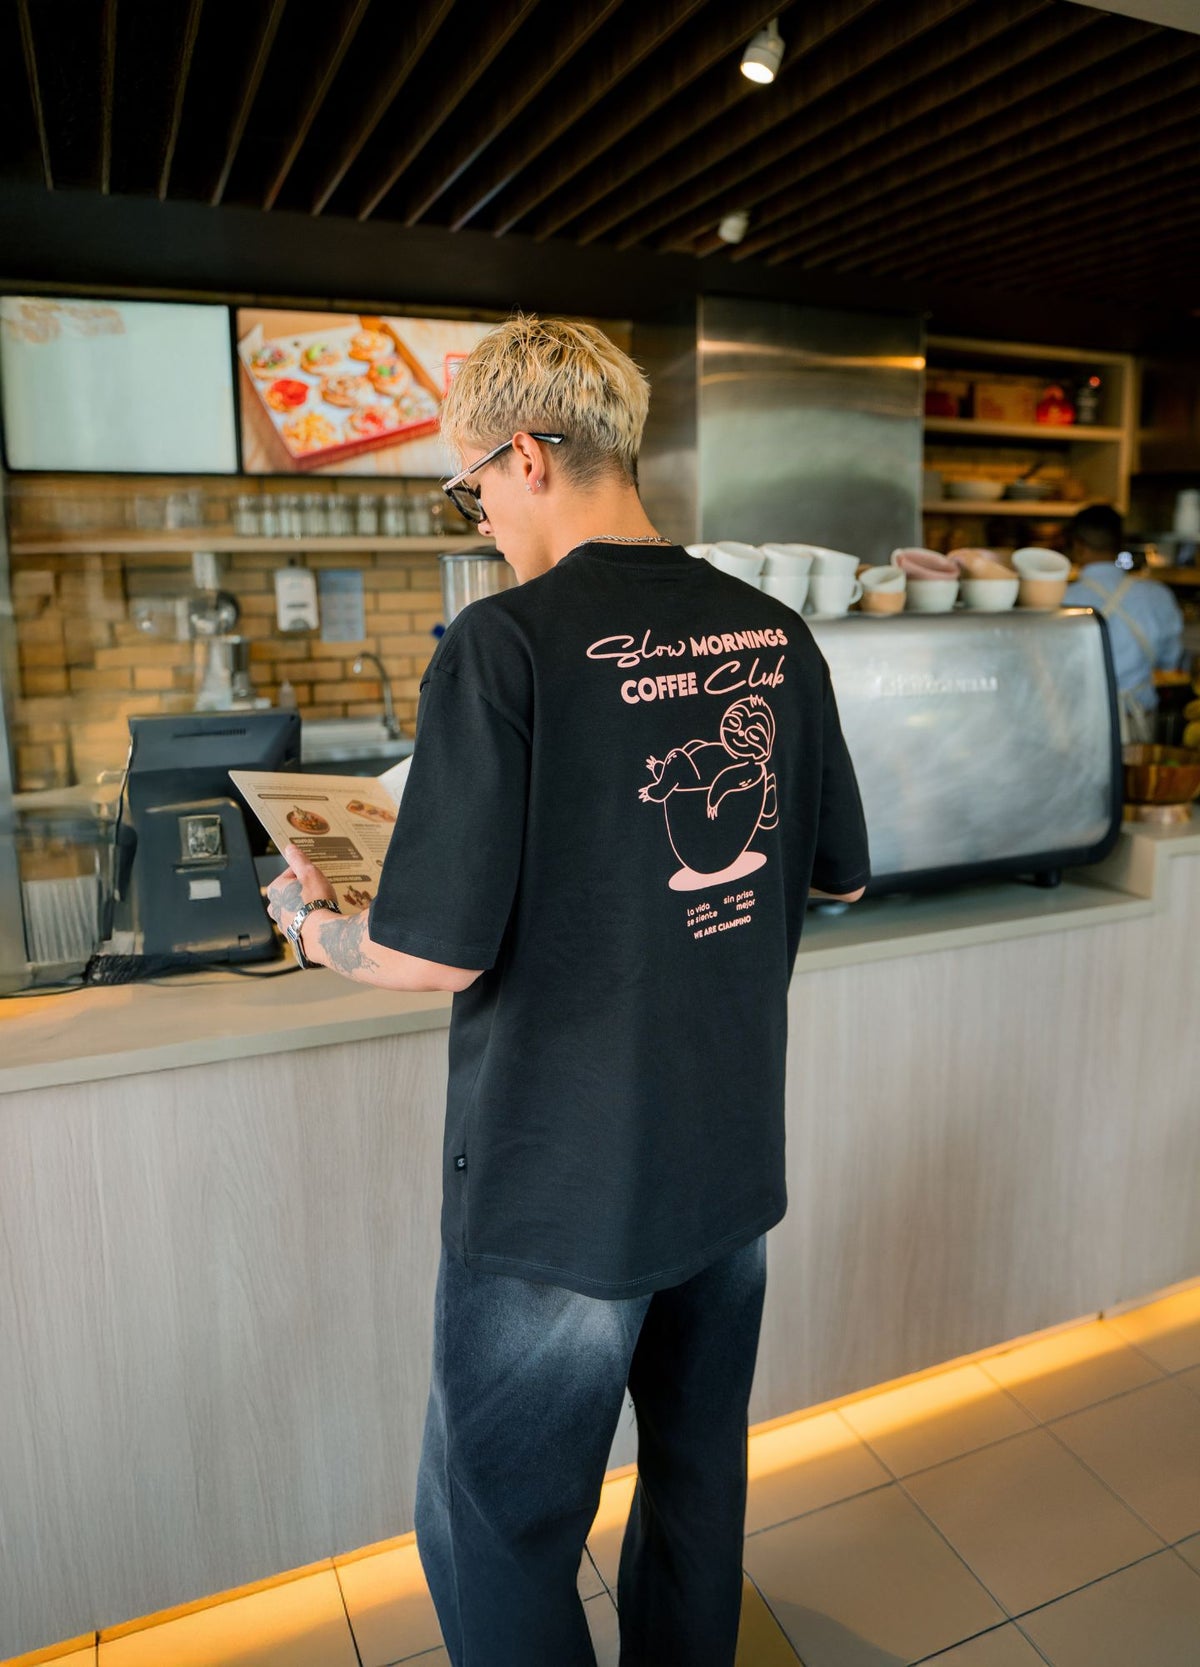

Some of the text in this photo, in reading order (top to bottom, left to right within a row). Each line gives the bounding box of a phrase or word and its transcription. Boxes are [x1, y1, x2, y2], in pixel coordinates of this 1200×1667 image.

[586, 628, 788, 668] Slow MORNINGS
[620, 655, 785, 704] COFFEE Club
[687, 898, 755, 927] se siente mejor
[723, 896, 735, 904] sin
[693, 915, 752, 939] WE ARE CIAMPINO
